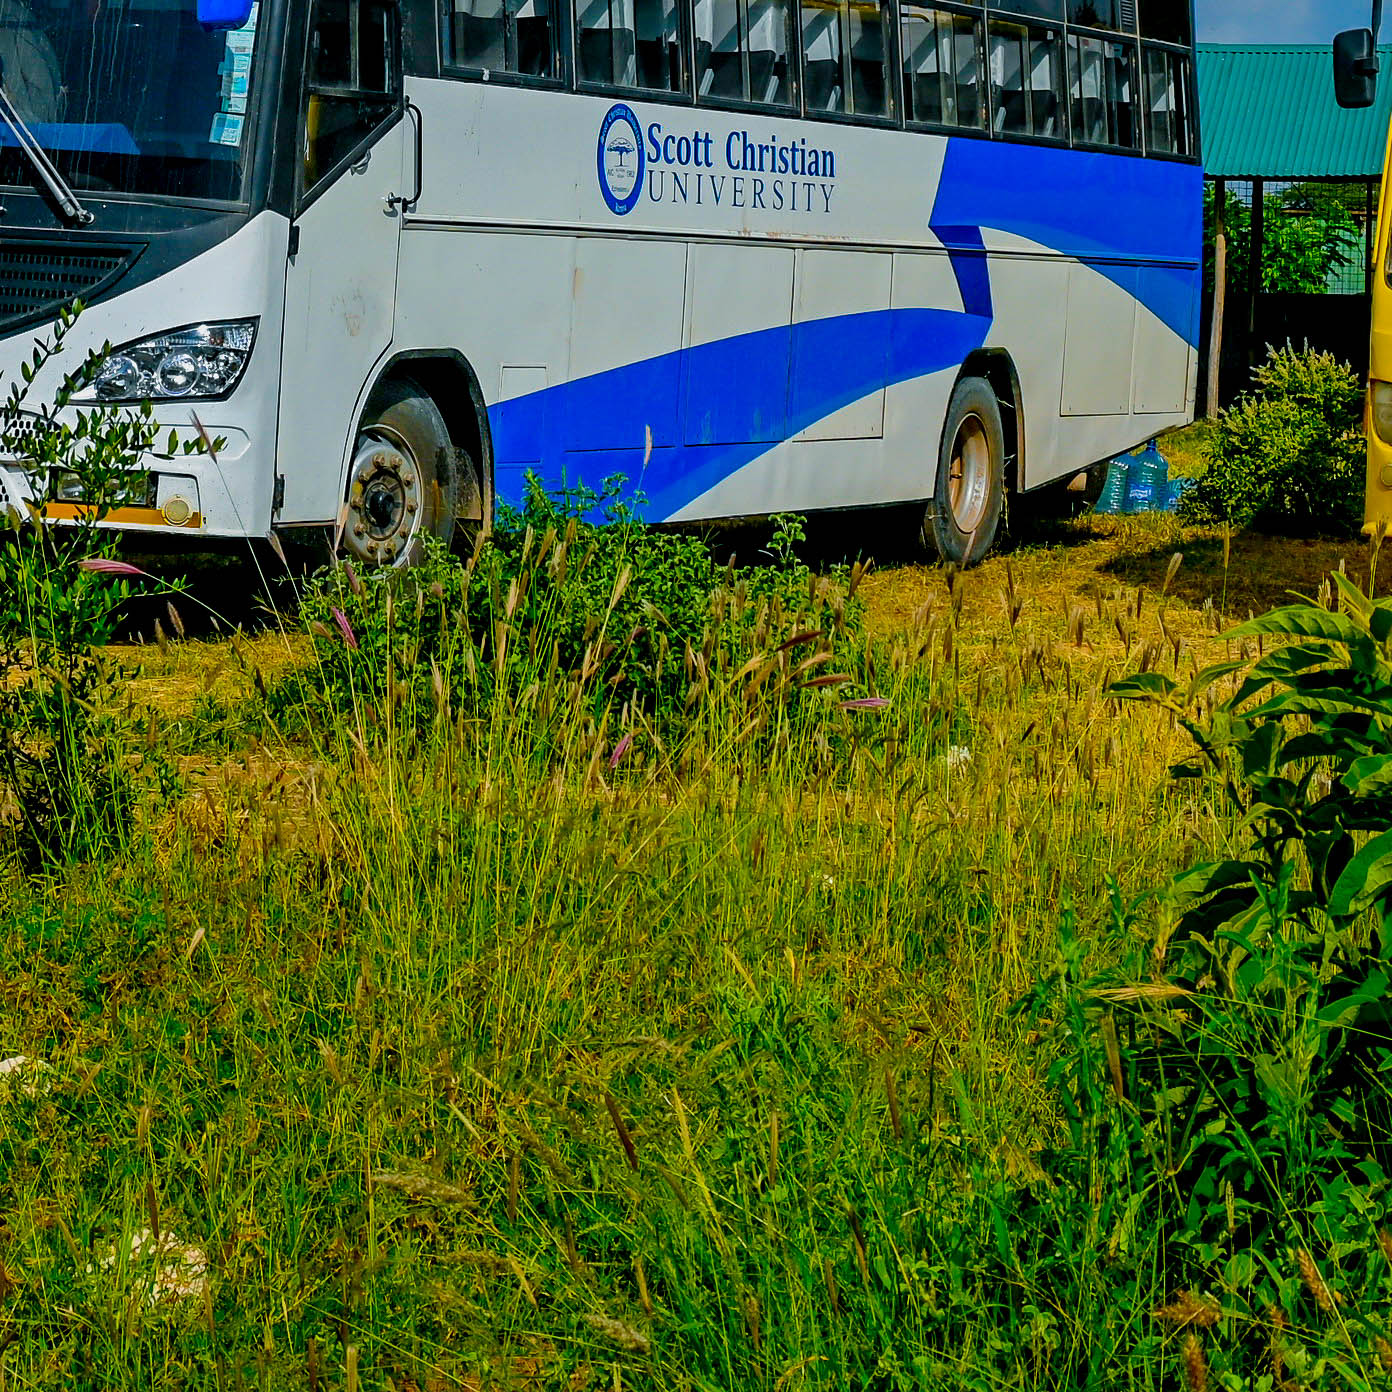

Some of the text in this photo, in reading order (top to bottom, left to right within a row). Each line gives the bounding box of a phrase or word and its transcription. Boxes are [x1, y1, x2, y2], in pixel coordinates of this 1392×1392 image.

[647, 122, 713, 168] Scott
[726, 131, 836, 178] Christian
[647, 169, 836, 213] UNIVERSITY
